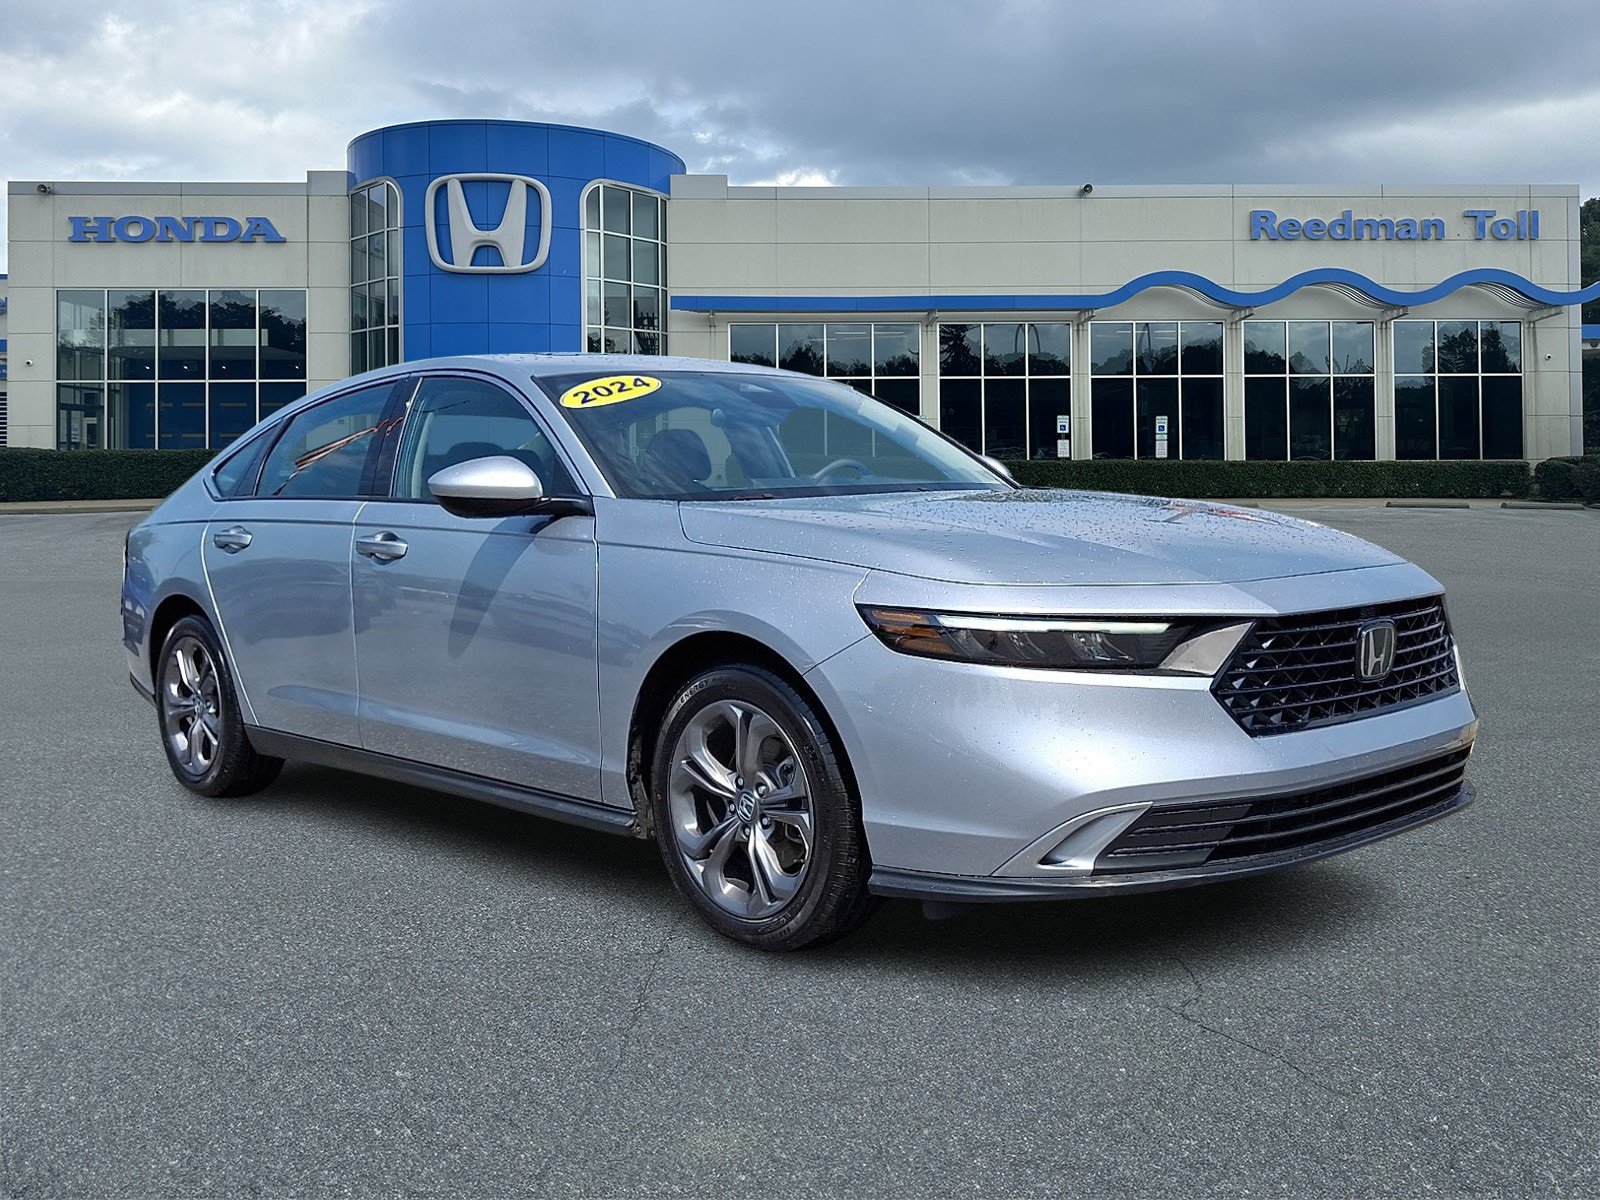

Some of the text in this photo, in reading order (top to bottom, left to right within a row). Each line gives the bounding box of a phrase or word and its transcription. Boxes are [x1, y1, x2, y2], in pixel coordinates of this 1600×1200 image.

[67, 215, 287, 243] HONDA
[1249, 209, 1540, 241] Reedman Toll
[573, 377, 651, 405] 2024
